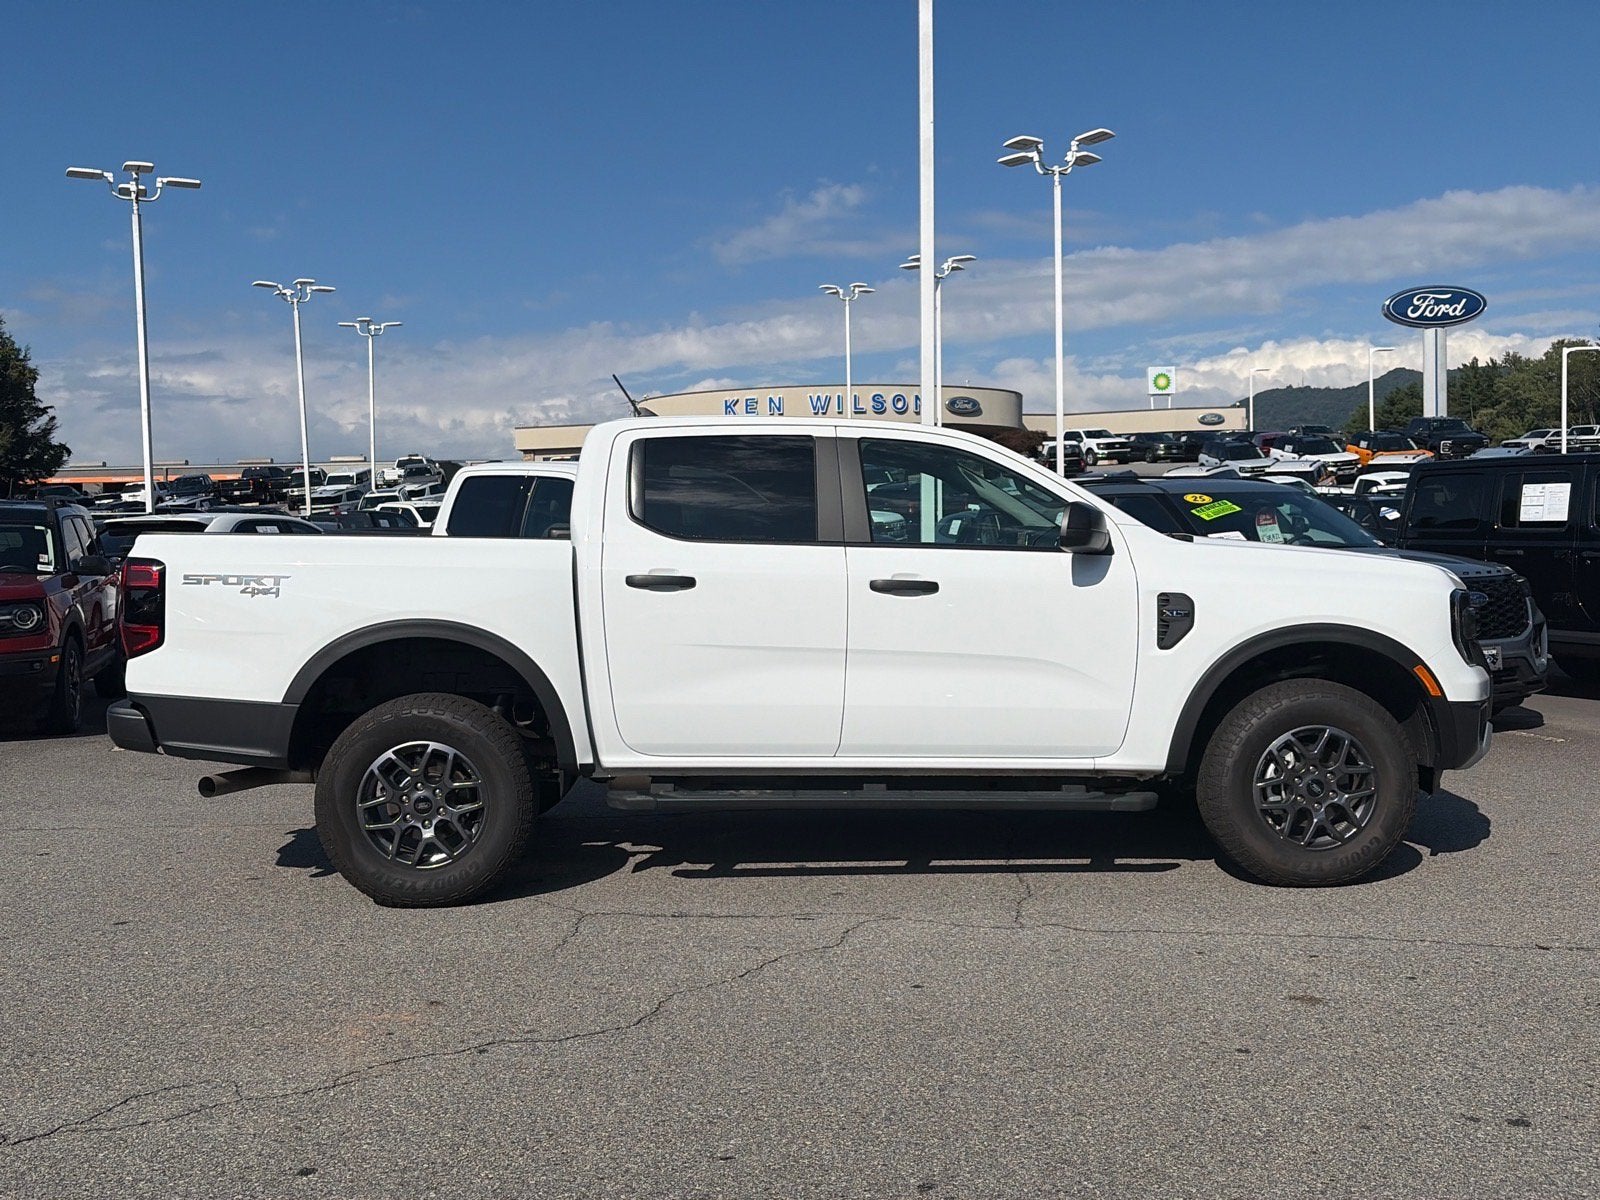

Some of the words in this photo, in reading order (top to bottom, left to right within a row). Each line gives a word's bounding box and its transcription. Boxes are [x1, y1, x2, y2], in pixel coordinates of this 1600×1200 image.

[1407, 293, 1467, 318] Ford
[723, 395, 784, 415] KEN
[181, 574, 292, 587] SPORT
[239, 586, 280, 599] 4x4
[1162, 609, 1189, 617] XLT
